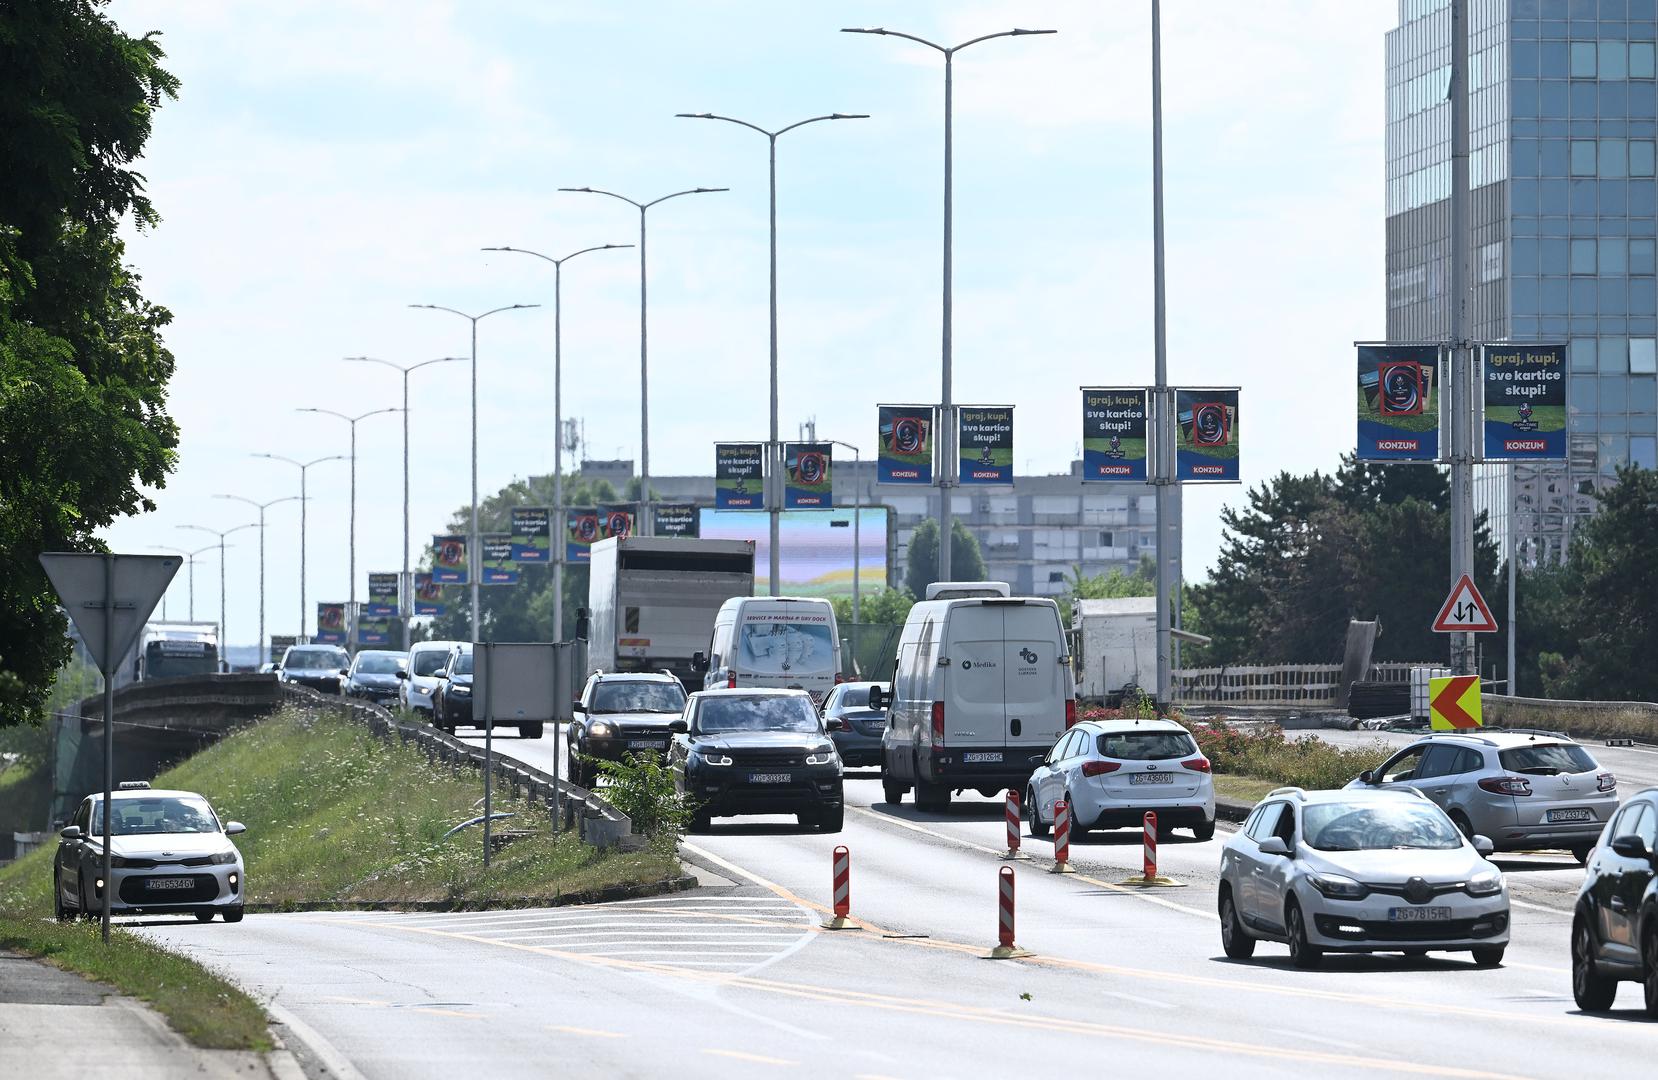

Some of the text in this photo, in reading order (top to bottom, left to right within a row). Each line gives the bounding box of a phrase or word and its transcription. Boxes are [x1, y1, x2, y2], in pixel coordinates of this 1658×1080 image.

[1490, 352, 1560, 366] Igraj, kupi,
[1489, 369, 1560, 381] sve kartice
[1505, 384, 1546, 397] skupi!
[1088, 395, 1141, 407] Igraj, kupi,
[964, 412, 1009, 422] Igraj, kupi,
[1107, 408, 1142, 418] kartice
[979, 423, 1010, 432] kartice
[1099, 421, 1131, 432] skupi!
[973, 434, 1000, 443] skupi!
[1378, 441, 1417, 450] KONZUM
[1506, 442, 1544, 450] KONZUM
[1193, 466, 1223, 474] KONZUM
[969, 753, 975, 761] ZG
[1136, 774, 1143, 782] ZG
[1553, 811, 1561, 820] ZG
[151, 880, 161, 888] ZG
[1397, 909, 1408, 919] ZG
